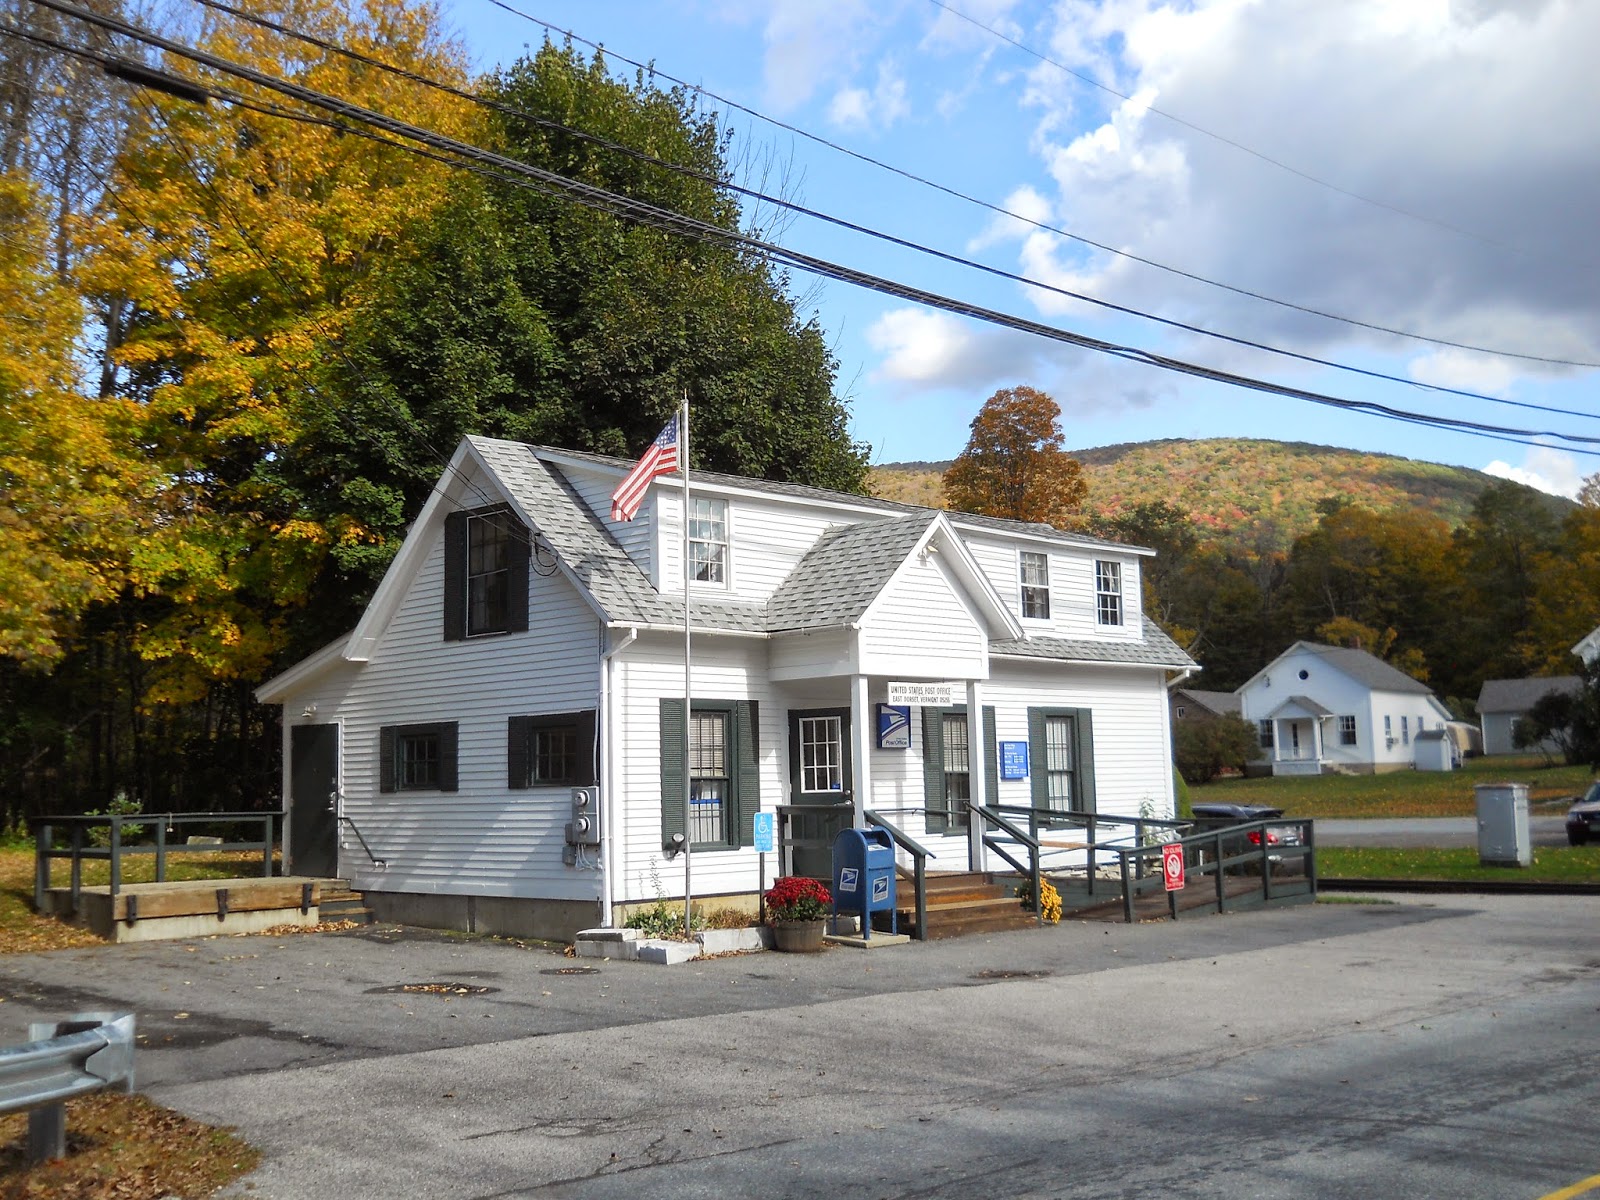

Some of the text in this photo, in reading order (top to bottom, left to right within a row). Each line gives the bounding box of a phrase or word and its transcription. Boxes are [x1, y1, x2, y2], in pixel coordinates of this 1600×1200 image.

[890, 686, 951, 695] UNITED STATES POST OFFICE
[892, 695, 903, 703] EAST
